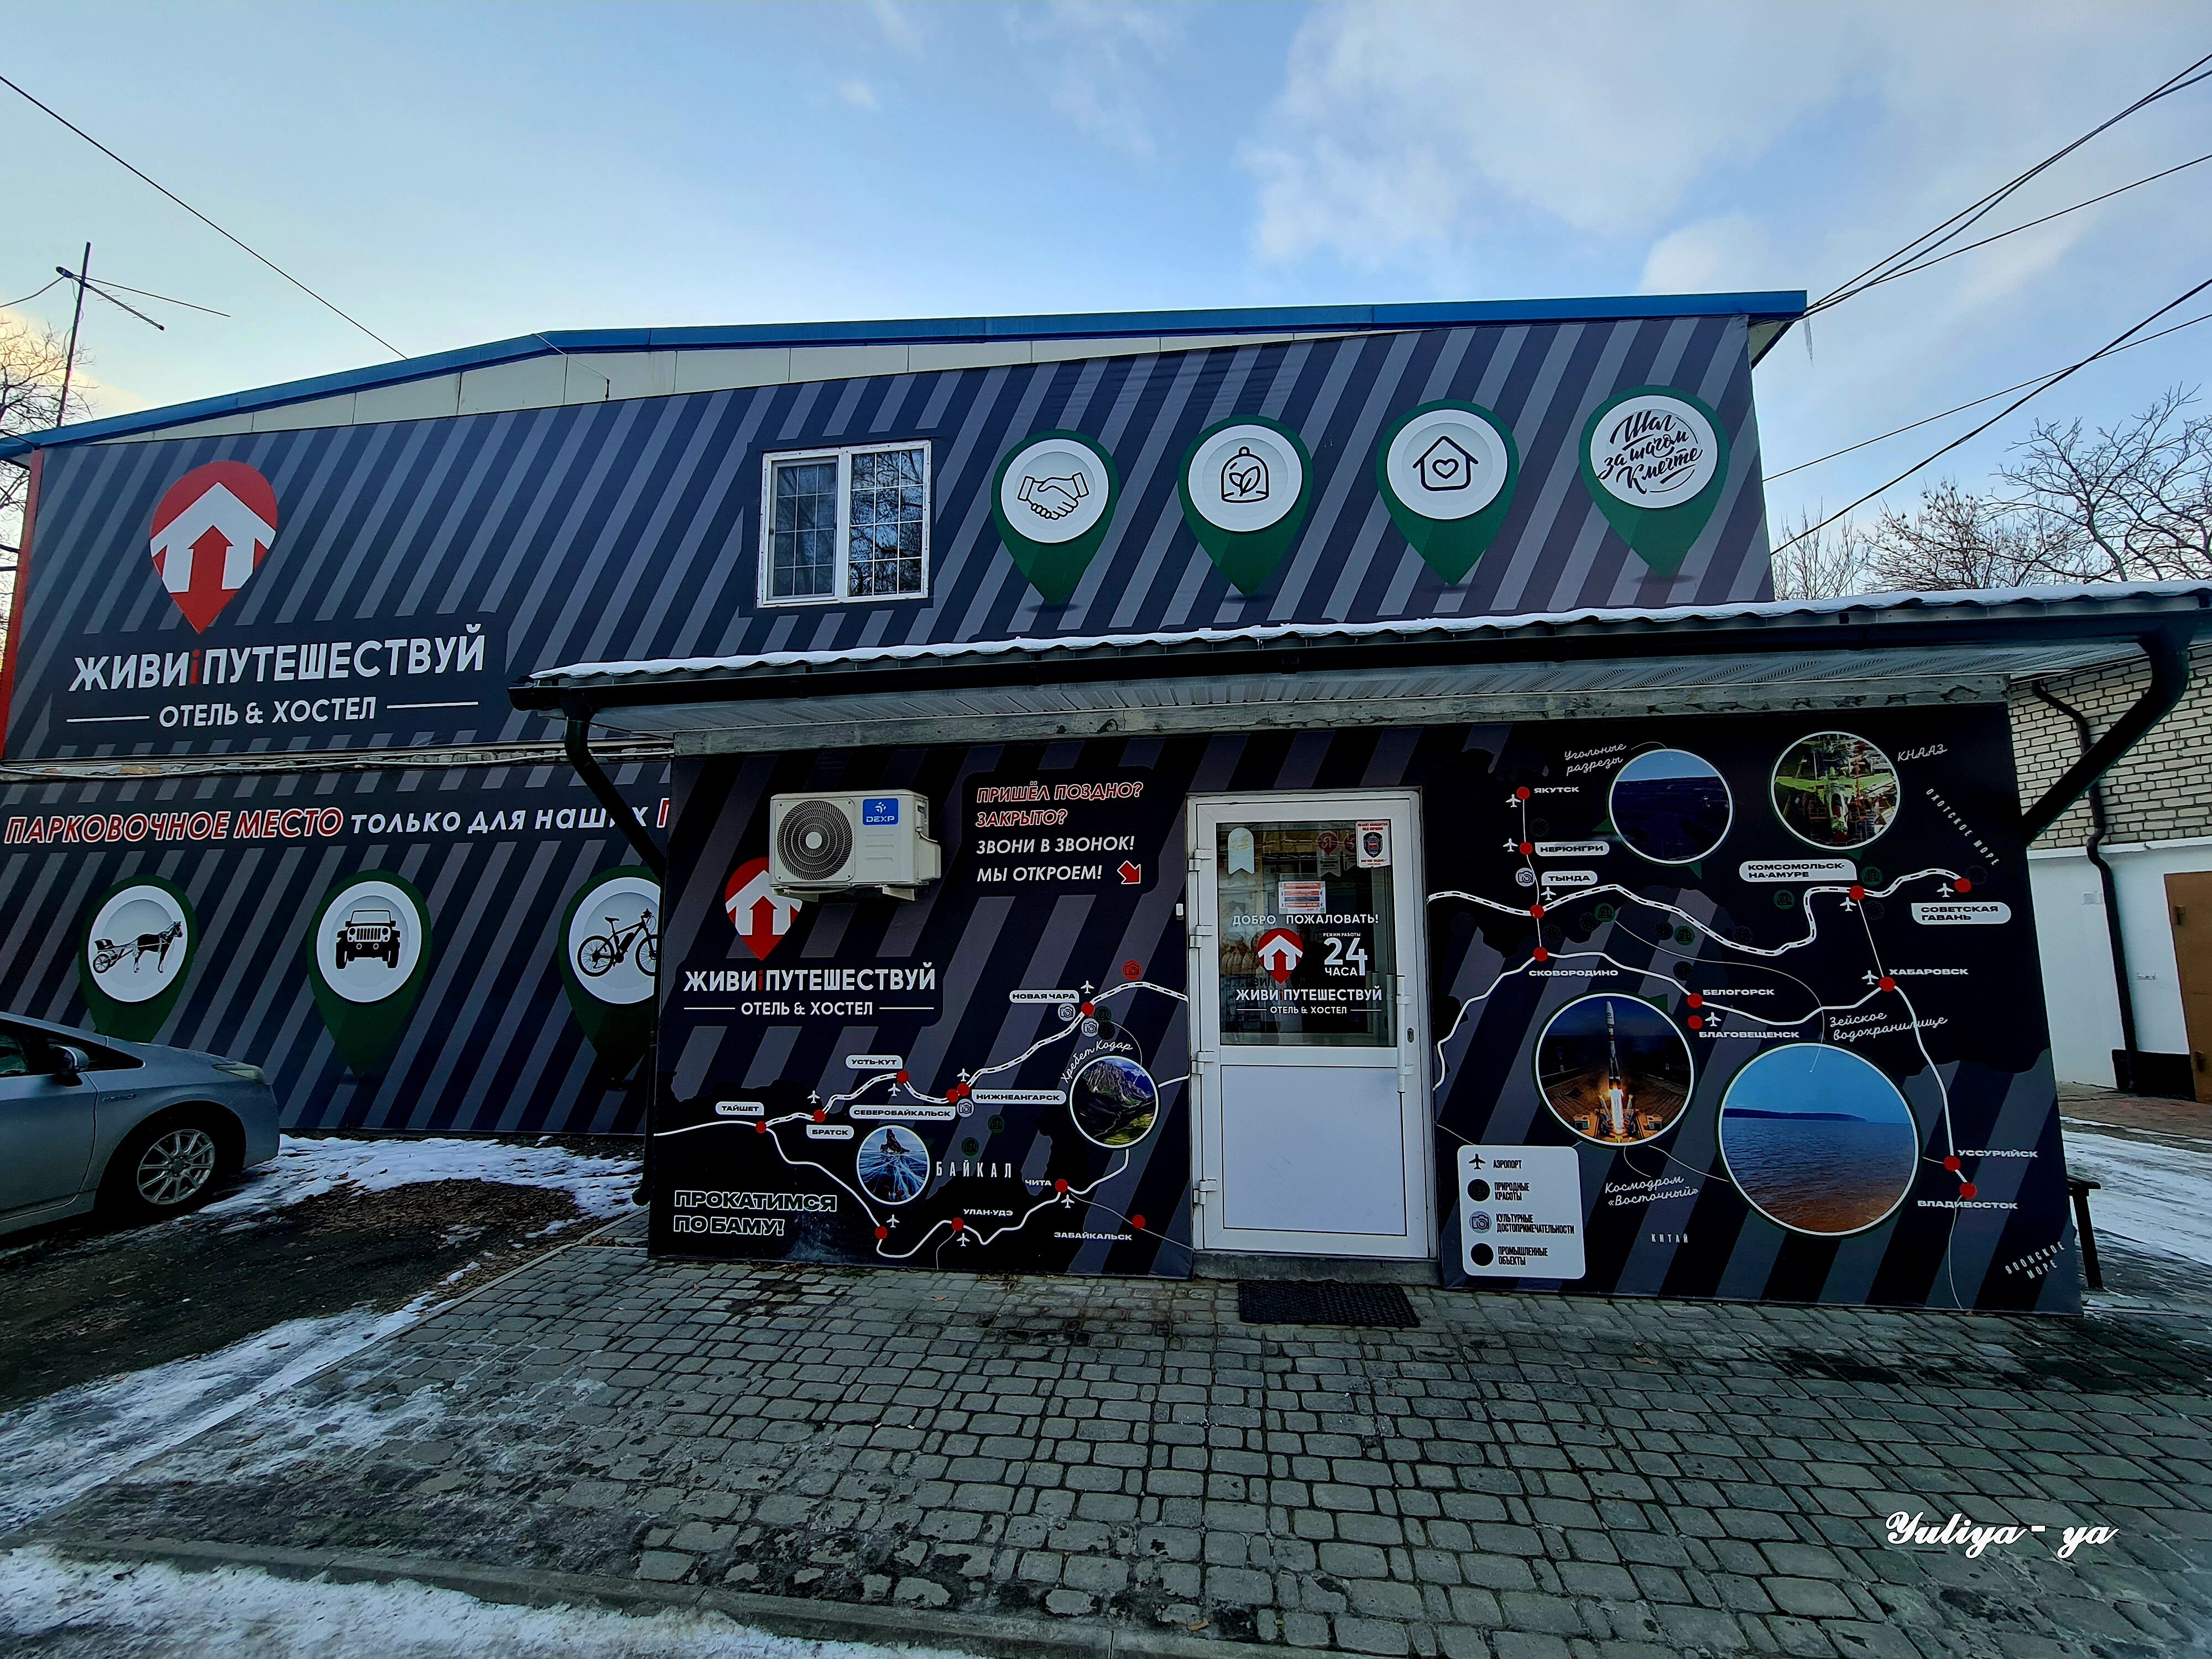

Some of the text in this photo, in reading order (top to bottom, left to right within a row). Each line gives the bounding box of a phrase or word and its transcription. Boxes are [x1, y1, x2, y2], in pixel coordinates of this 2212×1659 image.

[1610, 410, 1676, 444] Шаг
[1598, 430, 1689, 480] за шагом
[159, 696, 377, 728] ОТЕЛЬ & ХОСТЕЛ
[1564, 743, 1626, 760] Угольные
[1897, 744, 1947, 761] КНААЗ
[1567, 757, 1623, 776] разрезы
[977, 781, 1144, 803] ПРИШЁЛ ПОЗДНО?
[4, 813, 229, 844] ПАРКОВОЧНОЕ
[233, 807, 343, 839] МЕСТО
[534, 806, 649, 829] нашх
[975, 809, 1068, 827] ЗАКРЫТО?
[1926, 788, 1999, 865] ОХОТСКОЕ МОРЕ
[976, 836, 1134, 854] ЗВОНИ В ЗВОНОК!
[977, 865, 1102, 882] МЫ ОТКРОЕМ!
[1748, 862, 1845, 870] КОМСОМОЛЬСК-
[1232, 914, 1379, 927] ДОБРО ПОЖАЛОВАТЬ!
[1323, 937, 1368, 975] 24
[1324, 967, 1358, 976] ЧАСА
[741, 1001, 873, 1015] ОТЕЛЬ & ХОСТЕЛ
[1311, 1006, 1347, 1014] ХОСТЕЛ
[1830, 1013, 1887, 1027] Зейское
[1833, 1016, 1948, 1041] водохранилище
[1095, 1040, 1133, 1051] Кодар
[853, 1108, 951, 1117] СЕВЕРОБАЙКАЛЬСК
[1957, 1150, 2038, 1158] УССУРИЙСК
[936, 1160, 1011, 1178] БАЙКАЛ
[1493, 1159, 1522, 1169] АЭРОПОРТ
[1494, 1182, 1530, 1191] ПРИРОДНЫЕ
[1605, 1176, 1684, 1194] Космодром
[674, 1190, 837, 1212] ПРОКАТИМСЯ
[1495, 1192, 1522, 1201] КРАСОТЫ
[1918, 1200, 2018, 1209] ВЛАДИВОСТОК
[674, 1215, 785, 1236] ПО БАМУ!
[1496, 1213, 1533, 1223] КУЛЬТУРНЫЕ
[1496, 1223, 1575, 1234] ДОСТОПРИМЕЧАТЕЛЬНОСТИ
[1054, 1232, 1132, 1241] ЗАБАЙКАЛЬСК
[1498, 1246, 1548, 1256] ПРОМЫШЛЕННЫЕ
[1498, 1256, 1526, 1265] ОБЪЕКТЫ
